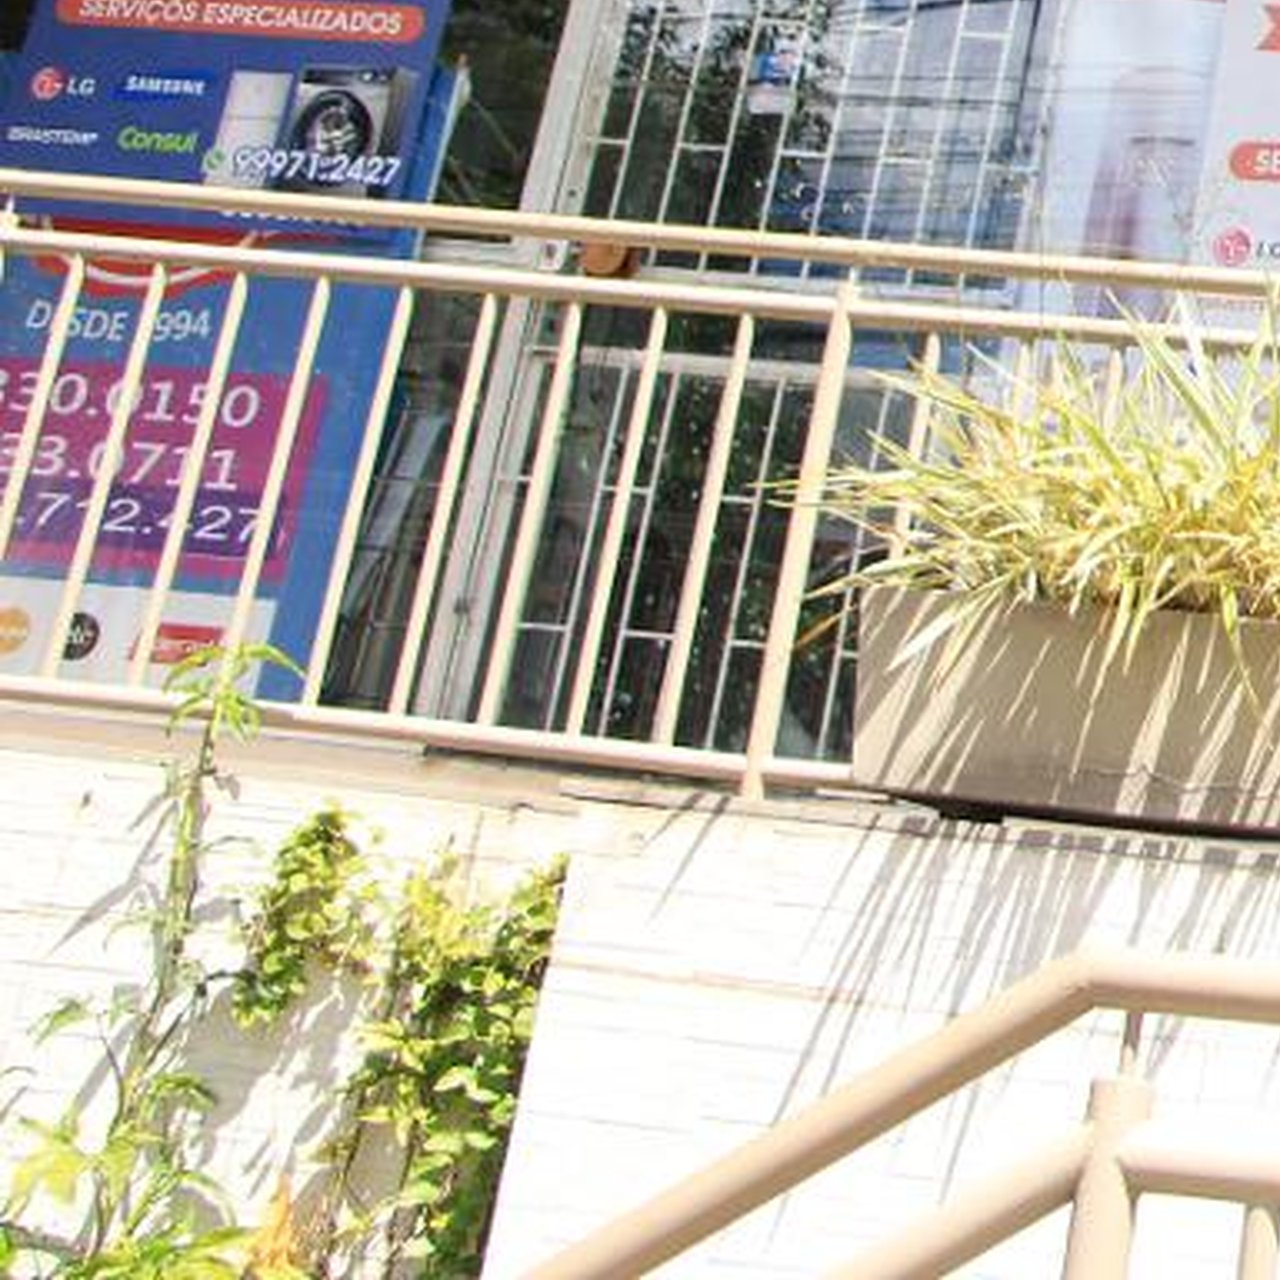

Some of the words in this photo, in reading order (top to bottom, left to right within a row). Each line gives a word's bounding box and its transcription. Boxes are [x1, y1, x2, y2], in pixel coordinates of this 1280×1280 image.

[202, 2, 402, 35] ESPECIALIZADOS
[66, 77, 97, 96] LG
[117, 125, 199, 154] Consul
[24, 300, 130, 342] DSDE
[136, 308, 211, 342] 994
